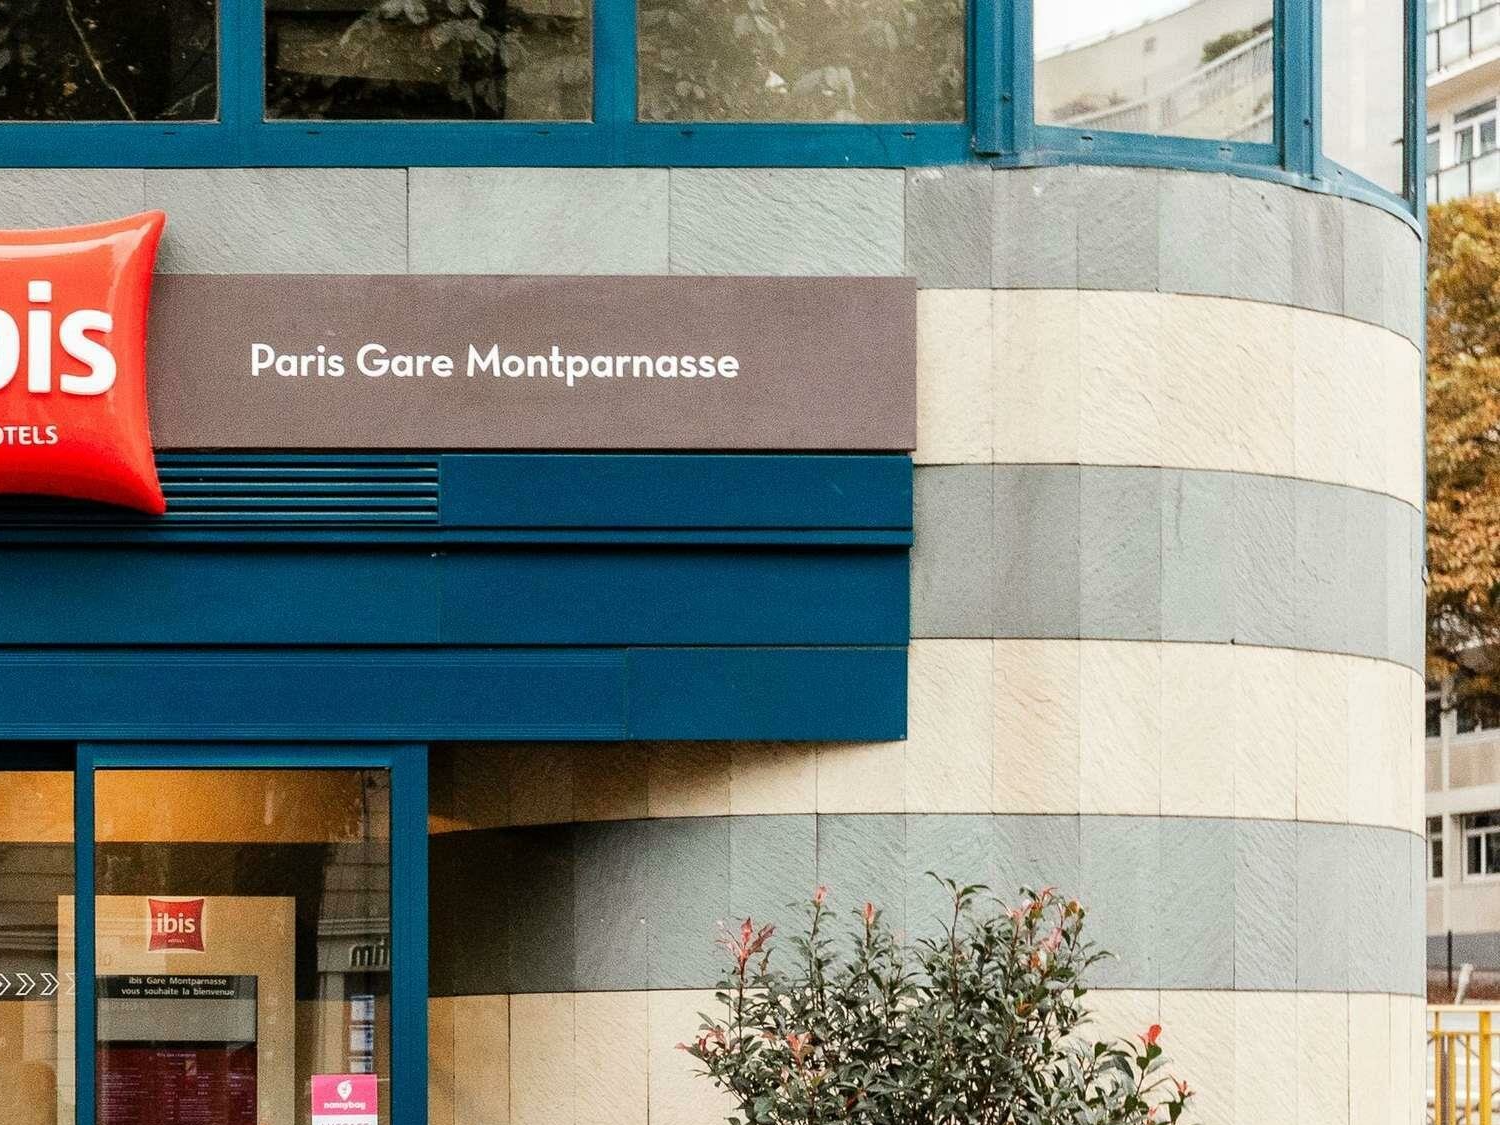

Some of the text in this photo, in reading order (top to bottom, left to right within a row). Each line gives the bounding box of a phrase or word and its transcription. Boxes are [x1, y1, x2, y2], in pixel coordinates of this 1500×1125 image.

[251, 343, 740, 387] Paris Gare Montparnasse
[156, 912, 197, 934] ibis
[128, 976, 227, 986] ibis Gare Montparnasse
[144, 986, 179, 995] souhaite
[182, 987, 190, 995] la
[193, 987, 235, 996] bienvenue
